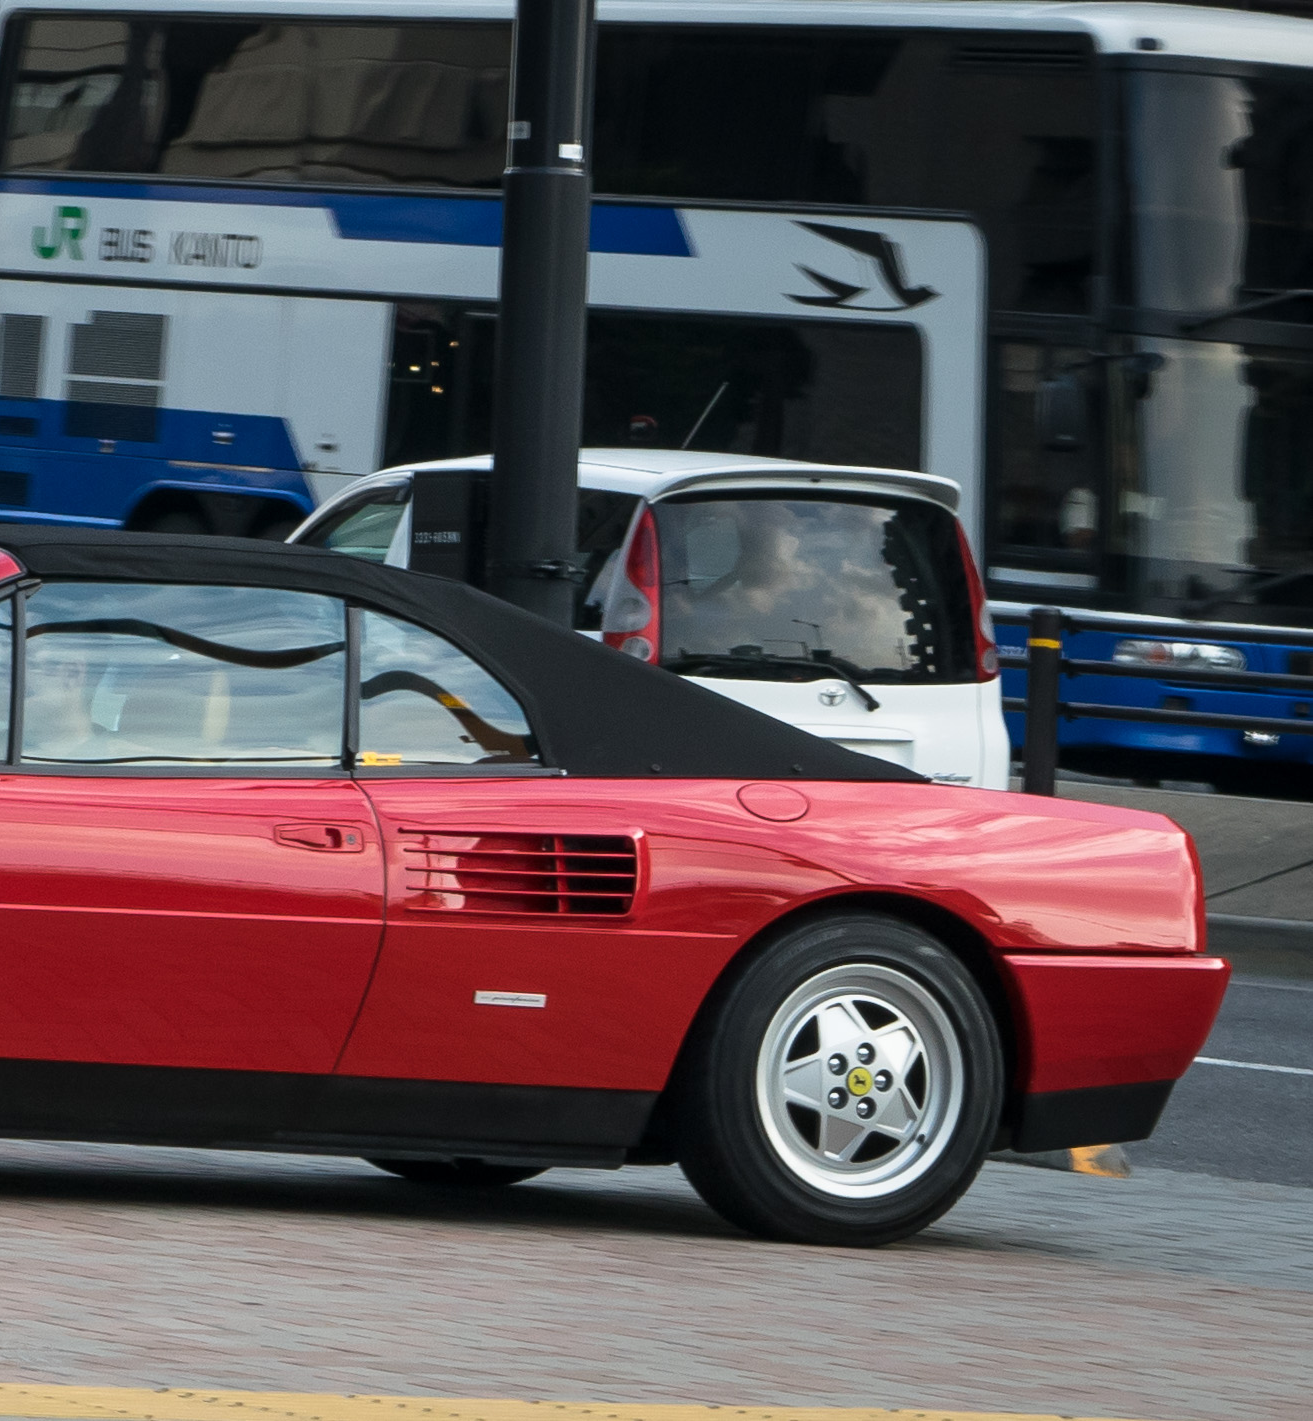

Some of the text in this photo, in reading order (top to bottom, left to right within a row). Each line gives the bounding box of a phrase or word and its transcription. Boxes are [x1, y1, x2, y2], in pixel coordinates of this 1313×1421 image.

[32, 205, 263, 269] JR BUS KANTO
